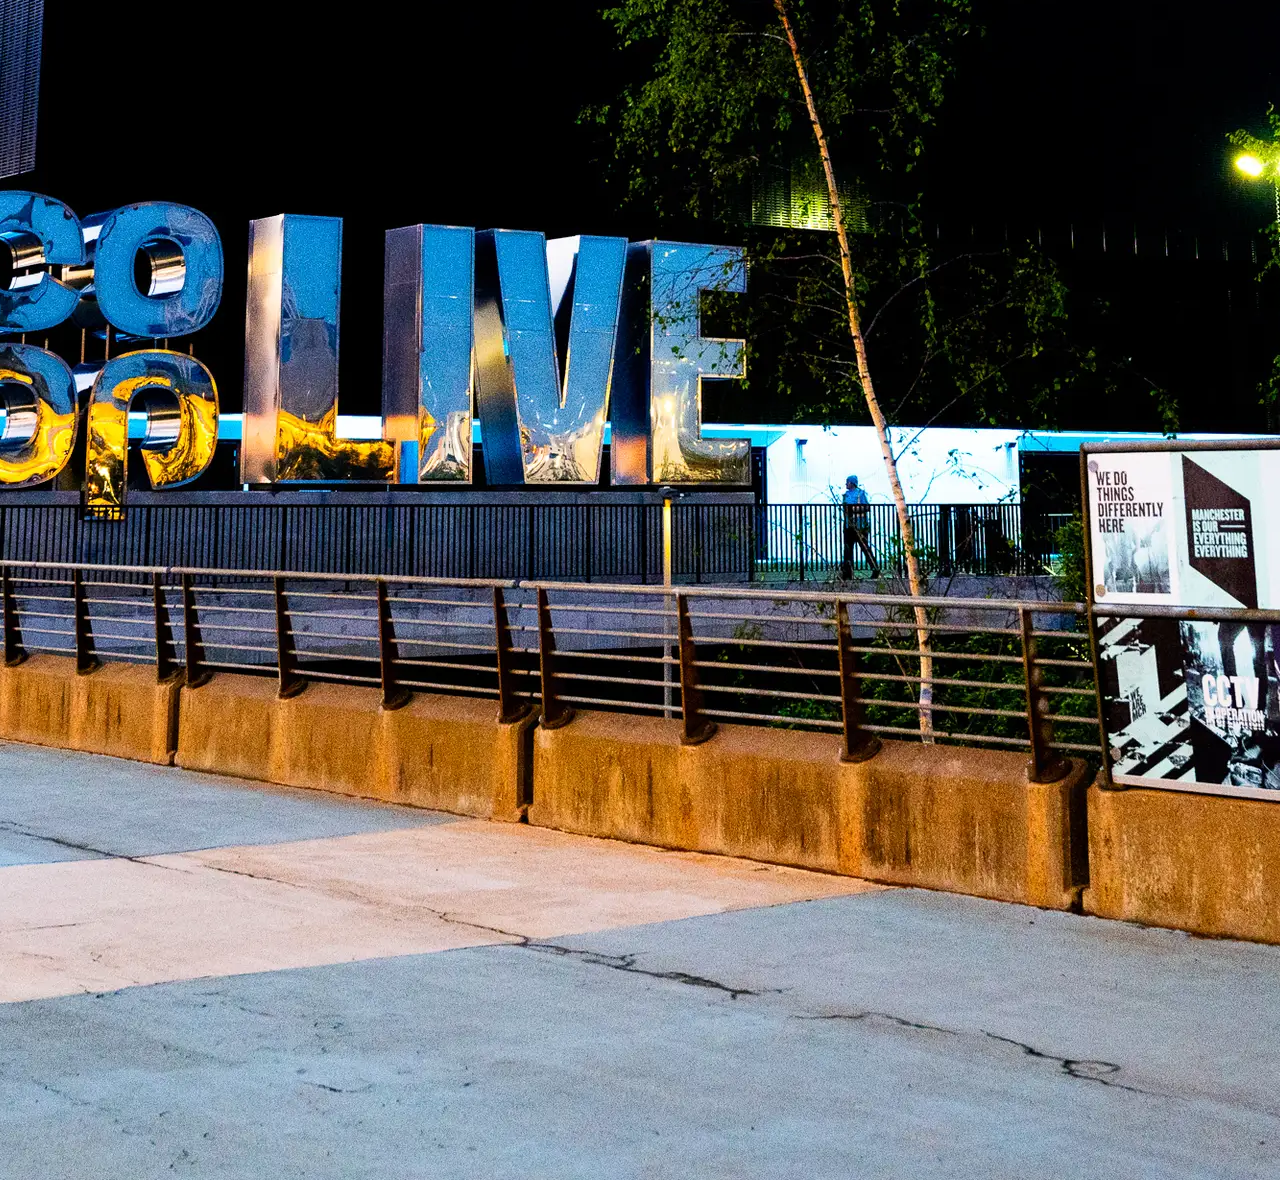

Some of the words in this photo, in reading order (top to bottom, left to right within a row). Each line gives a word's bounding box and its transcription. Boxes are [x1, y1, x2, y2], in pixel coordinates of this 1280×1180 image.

[240, 212, 753, 487] LIVE
[1096, 471, 1111, 486] WE
[1114, 471, 1128, 486] DO
[1096, 487, 1134, 501] THINGS
[1098, 502, 1164, 518] DIFFERENTLY
[1191, 508, 1245, 521] MANCHESTER
[1099, 518, 1125, 533] HERE
[1193, 521, 1201, 532] IS
[1202, 521, 1218, 532] OUR
[1193, 532, 1247, 546] EVERYTHING
[1194, 545, 1248, 558] EVERYTHING
[1201, 673, 1260, 710] CCTV
